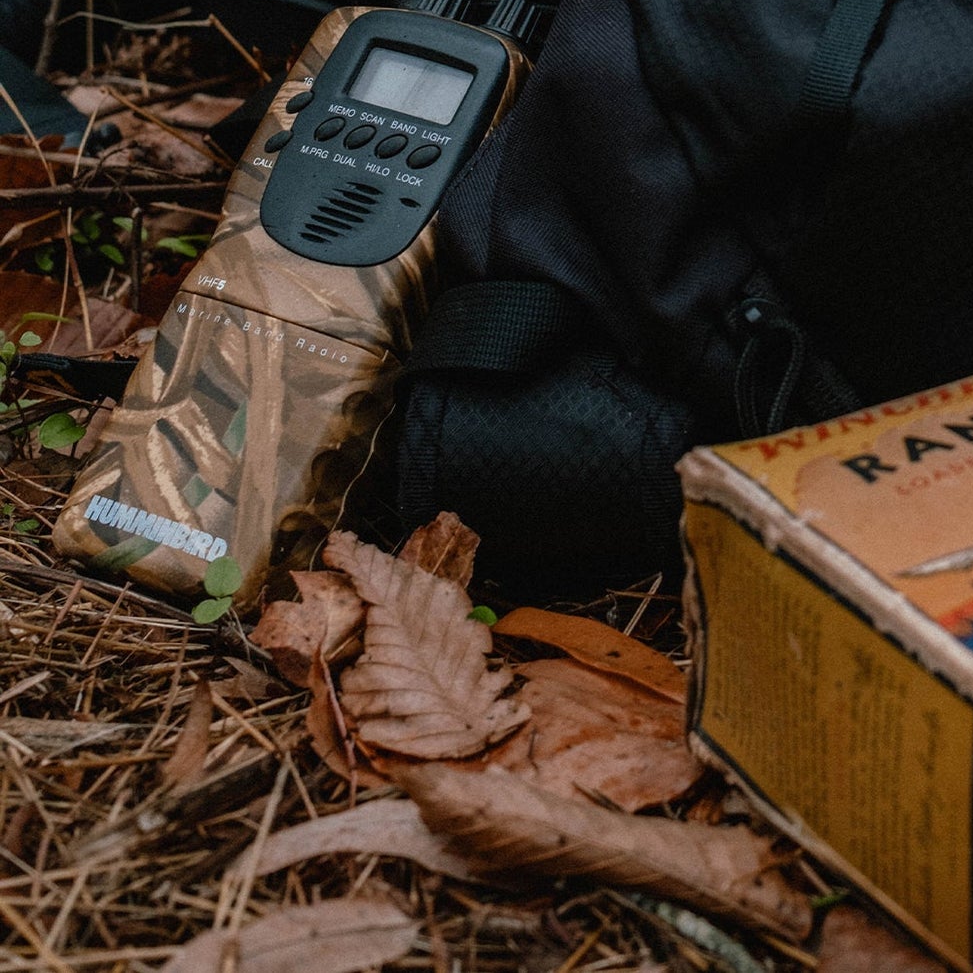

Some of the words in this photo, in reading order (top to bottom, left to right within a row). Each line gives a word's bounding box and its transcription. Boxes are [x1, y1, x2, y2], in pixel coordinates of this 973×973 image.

[328, 104, 356, 118] MEMO
[359, 112, 386, 126] SCAN
[390, 120, 418, 135] BAND
[421, 130, 452, 145] LIGHT
[253, 157, 274, 169] CALL
[300, 145, 329, 159] M.PRG
[333, 153, 357, 168] DUAL
[365, 162, 391, 176] HI/LO
[396, 171, 424, 187] LOCK
[198, 275, 227, 290] VHF5
[176, 303, 232, 326] Marine
[242, 321, 285, 342] Band
[296, 337, 348, 363] Radio
[84, 494, 228, 563] HUMMINBIRD
